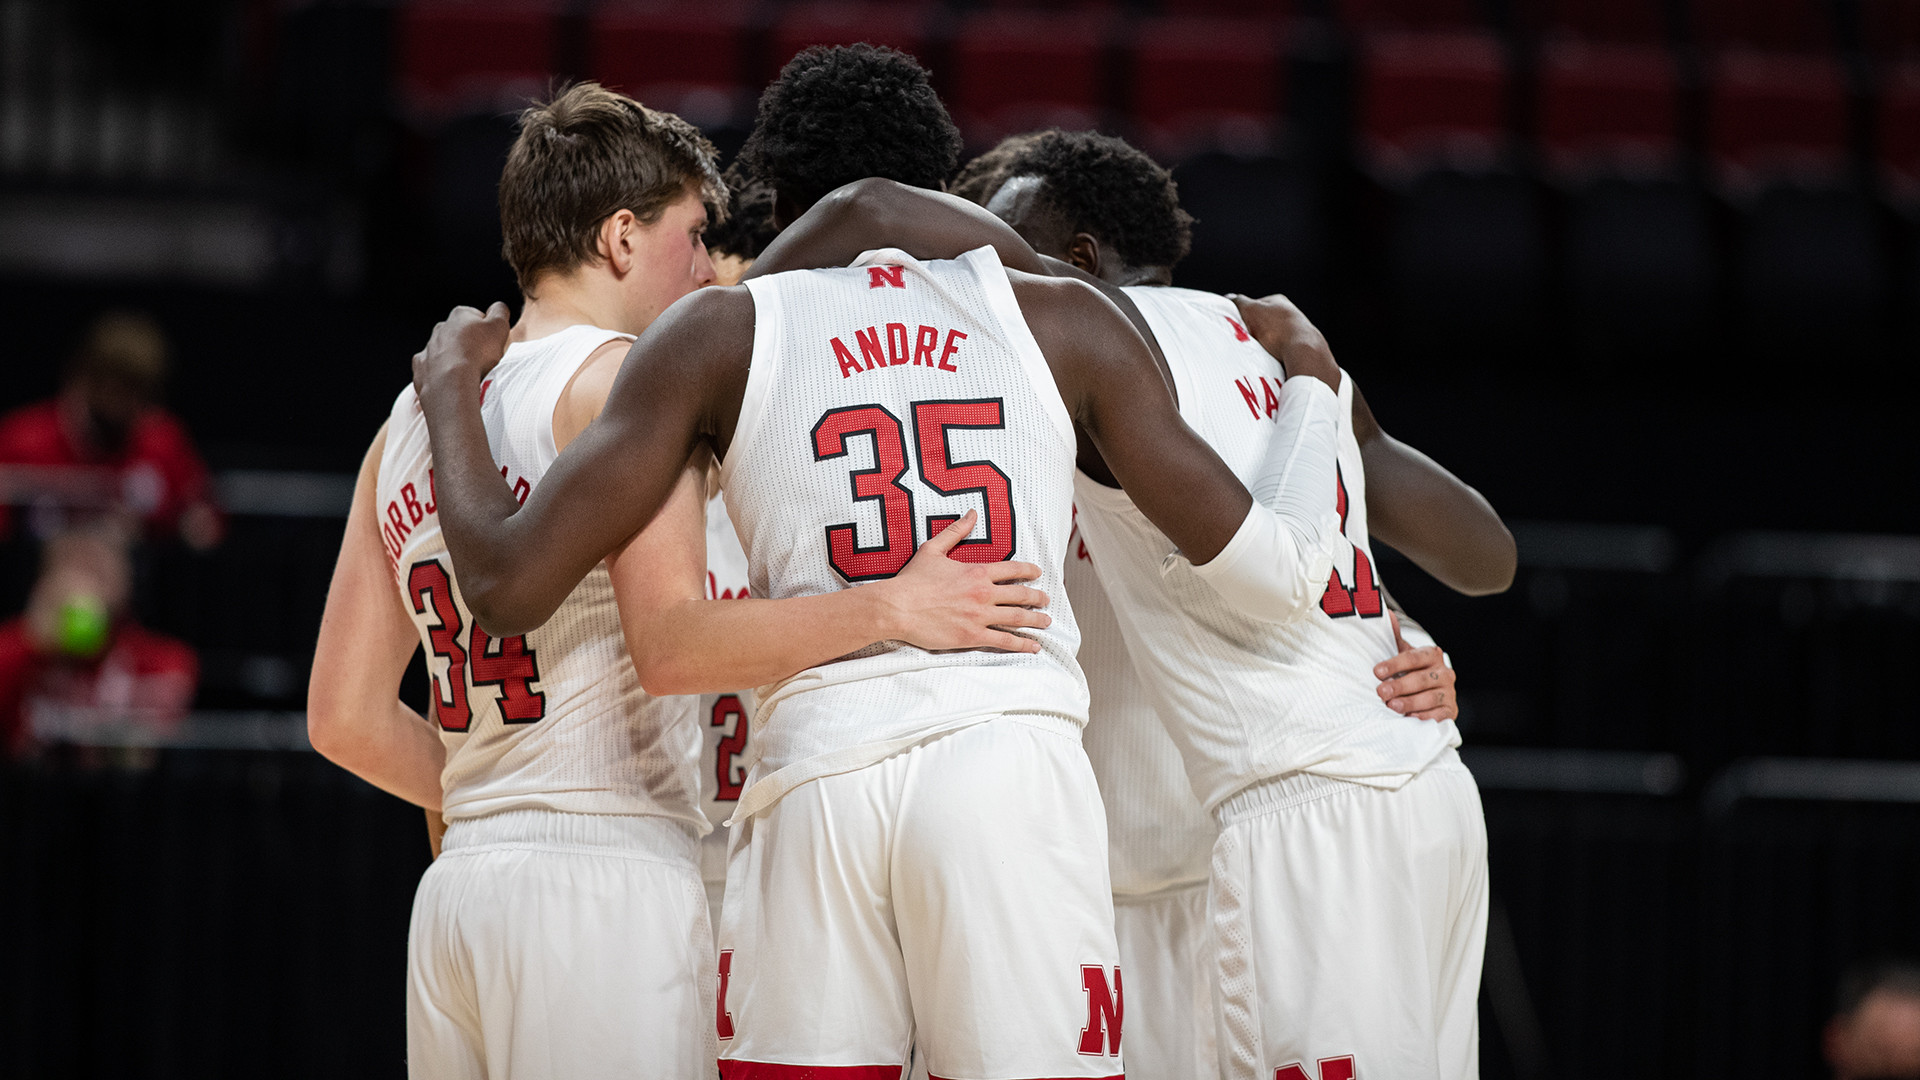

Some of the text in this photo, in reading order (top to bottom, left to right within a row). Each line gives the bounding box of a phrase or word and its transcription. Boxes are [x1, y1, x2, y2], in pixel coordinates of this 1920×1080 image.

[867, 265, 906, 290] N
[829, 322, 968, 379] ANDRE
[810, 396, 1017, 583] 35
[408, 558, 546, 734] 34
[1077, 963, 1124, 1057] N
